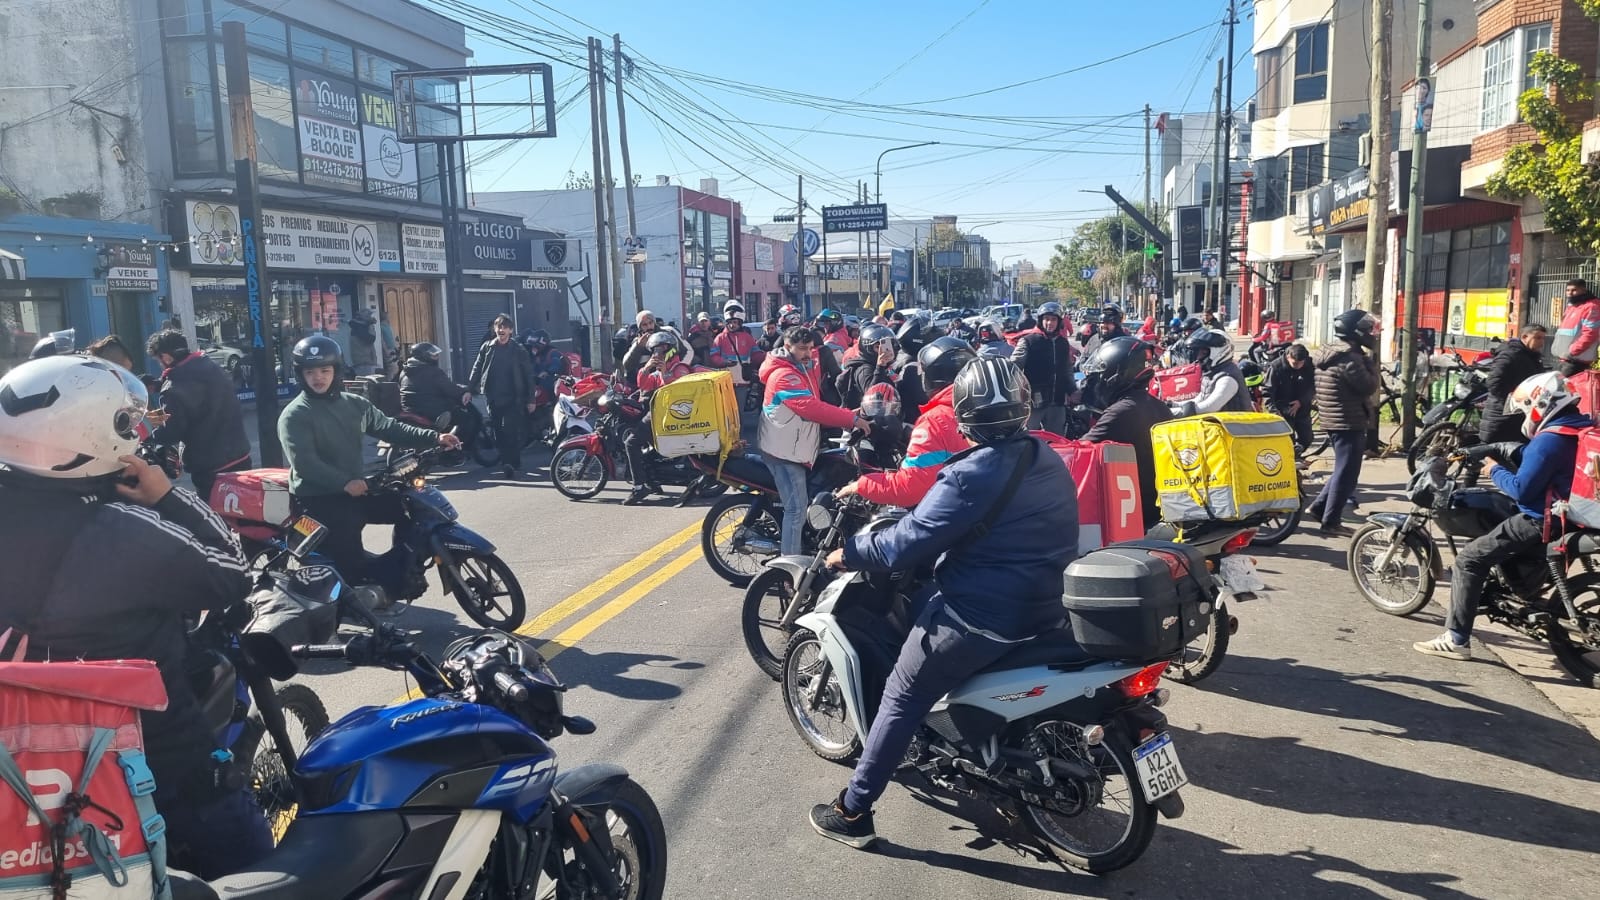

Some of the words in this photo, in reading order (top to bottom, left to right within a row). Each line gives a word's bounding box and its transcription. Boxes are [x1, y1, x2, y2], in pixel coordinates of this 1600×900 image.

[311, 79, 358, 125] Young
[361, 92, 396, 129] VEN
[304, 119, 340, 141] VENTA
[342, 129, 357, 145] EN
[311, 138, 354, 159] BLOQUE
[312, 159, 363, 180] 11-2476-2370
[825, 207, 883, 217] TODOWAGEN
[1330, 207, 1347, 226] CHAPA
[1350, 198, 1369, 219] PINTUR
[280, 216, 312, 231] PREMIOS
[317, 220, 349, 234] MEDALLAS
[465, 221, 522, 241] PEUGEOT
[299, 235, 351, 251] ENTRENAMIENTO
[126, 249, 152, 265] Young
[378, 250, 397, 261] 6128
[474, 245, 517, 260] QUILMES
[117, 269, 149, 278] VENDE
[522, 279, 558, 289] REPUESTOS
[1185, 473, 1218, 486] COMDA
[1267, 480, 1292, 491] COMIDA
[1146, 747, 1172, 775] A21
[1148, 764, 1183, 797] 5GHX
